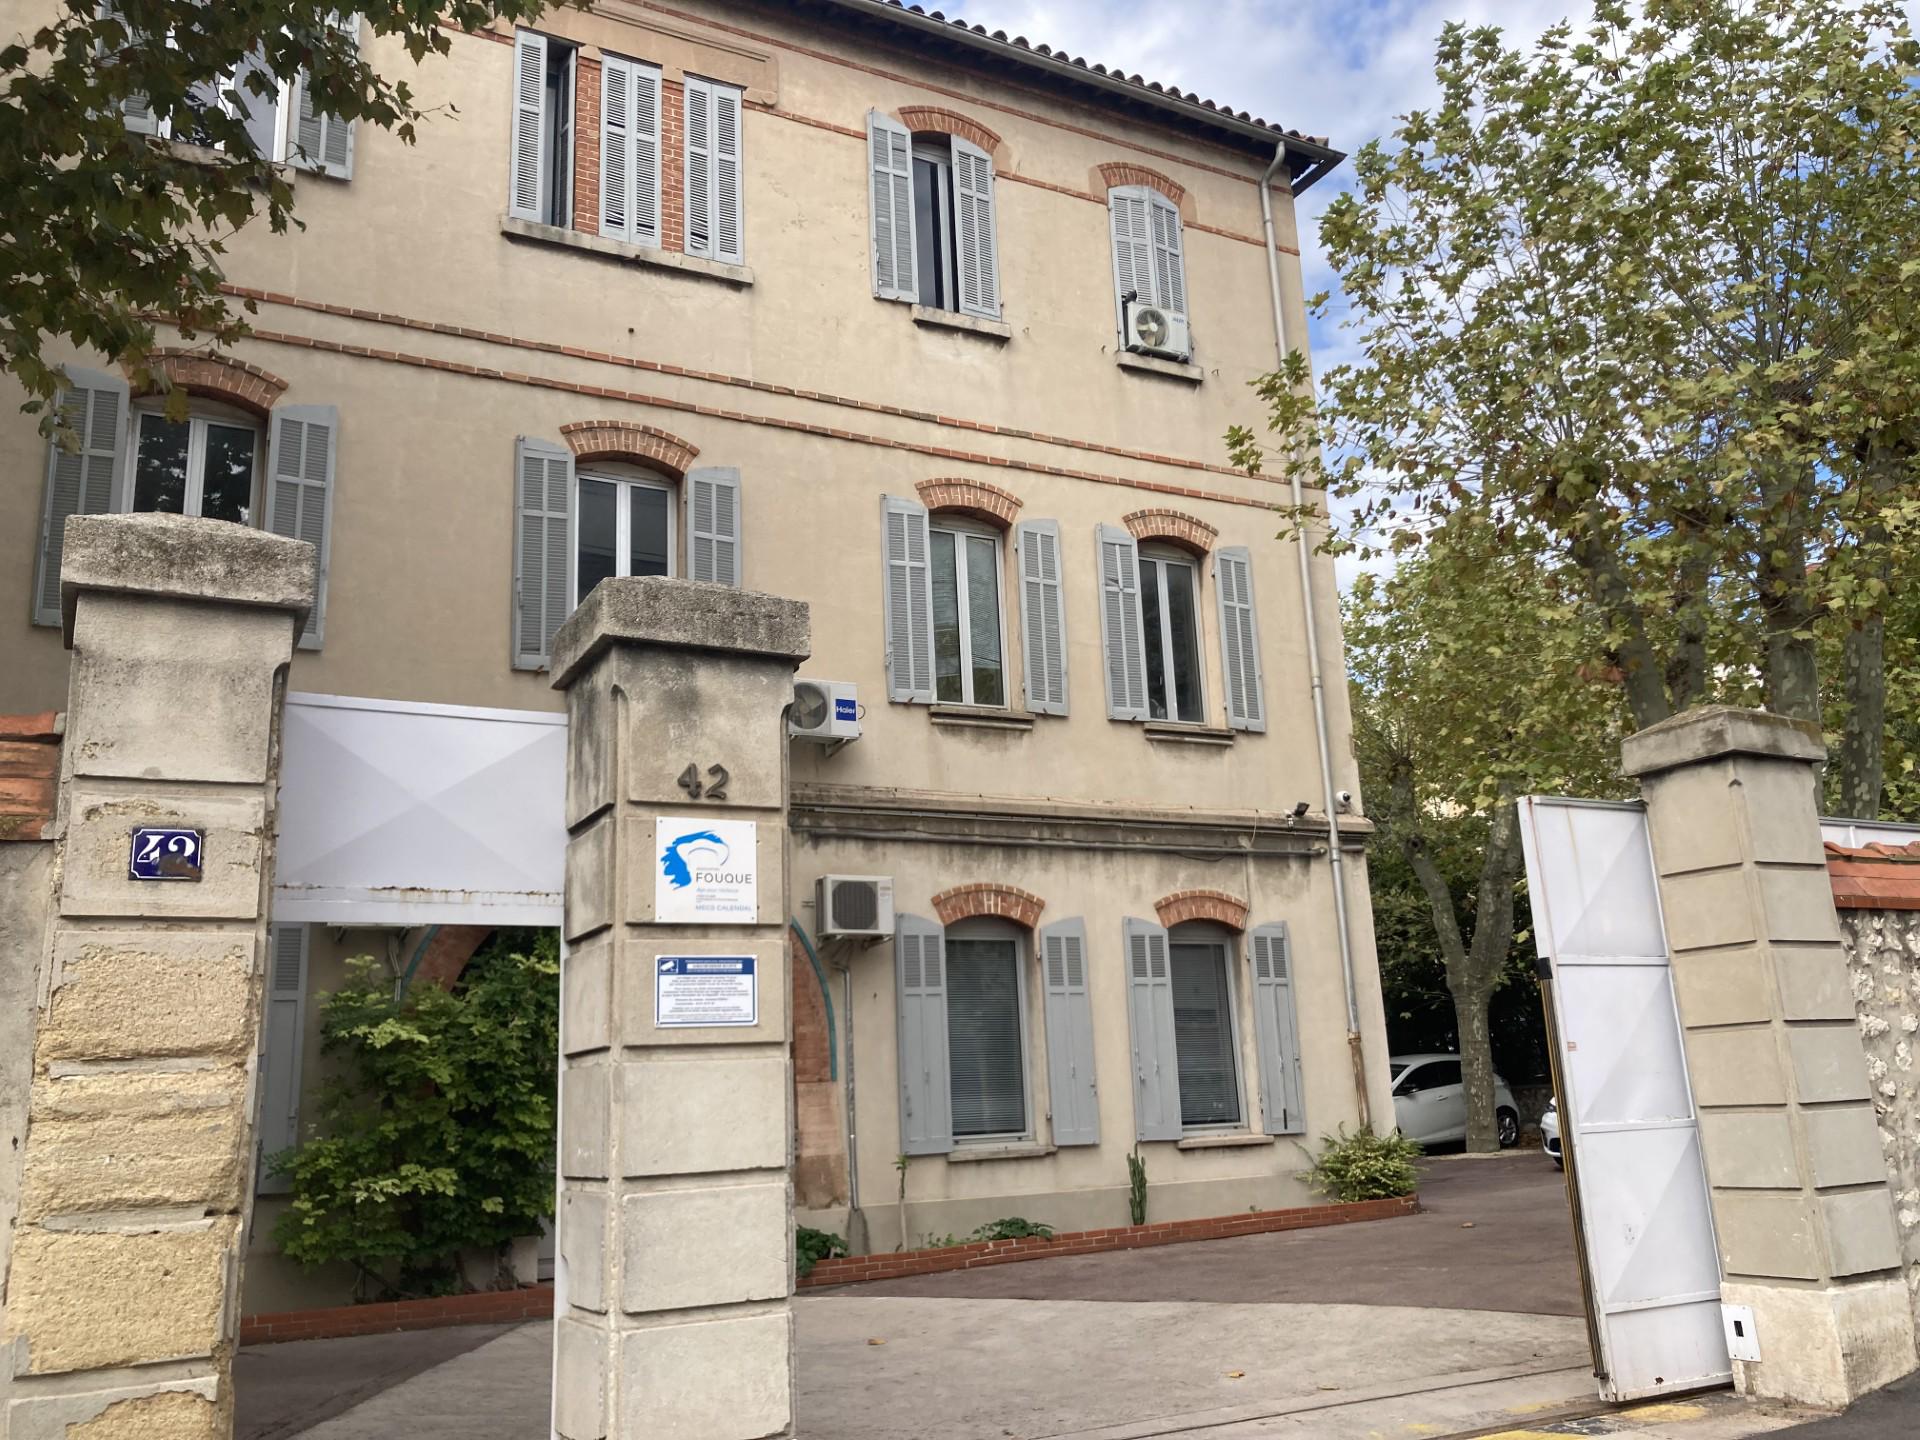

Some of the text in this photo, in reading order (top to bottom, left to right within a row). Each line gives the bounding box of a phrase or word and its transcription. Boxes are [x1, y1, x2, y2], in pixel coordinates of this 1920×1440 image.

[836, 705, 856, 714] Haier
[677, 762, 729, 800] 42
[696, 872, 752, 884] FOUQUE
